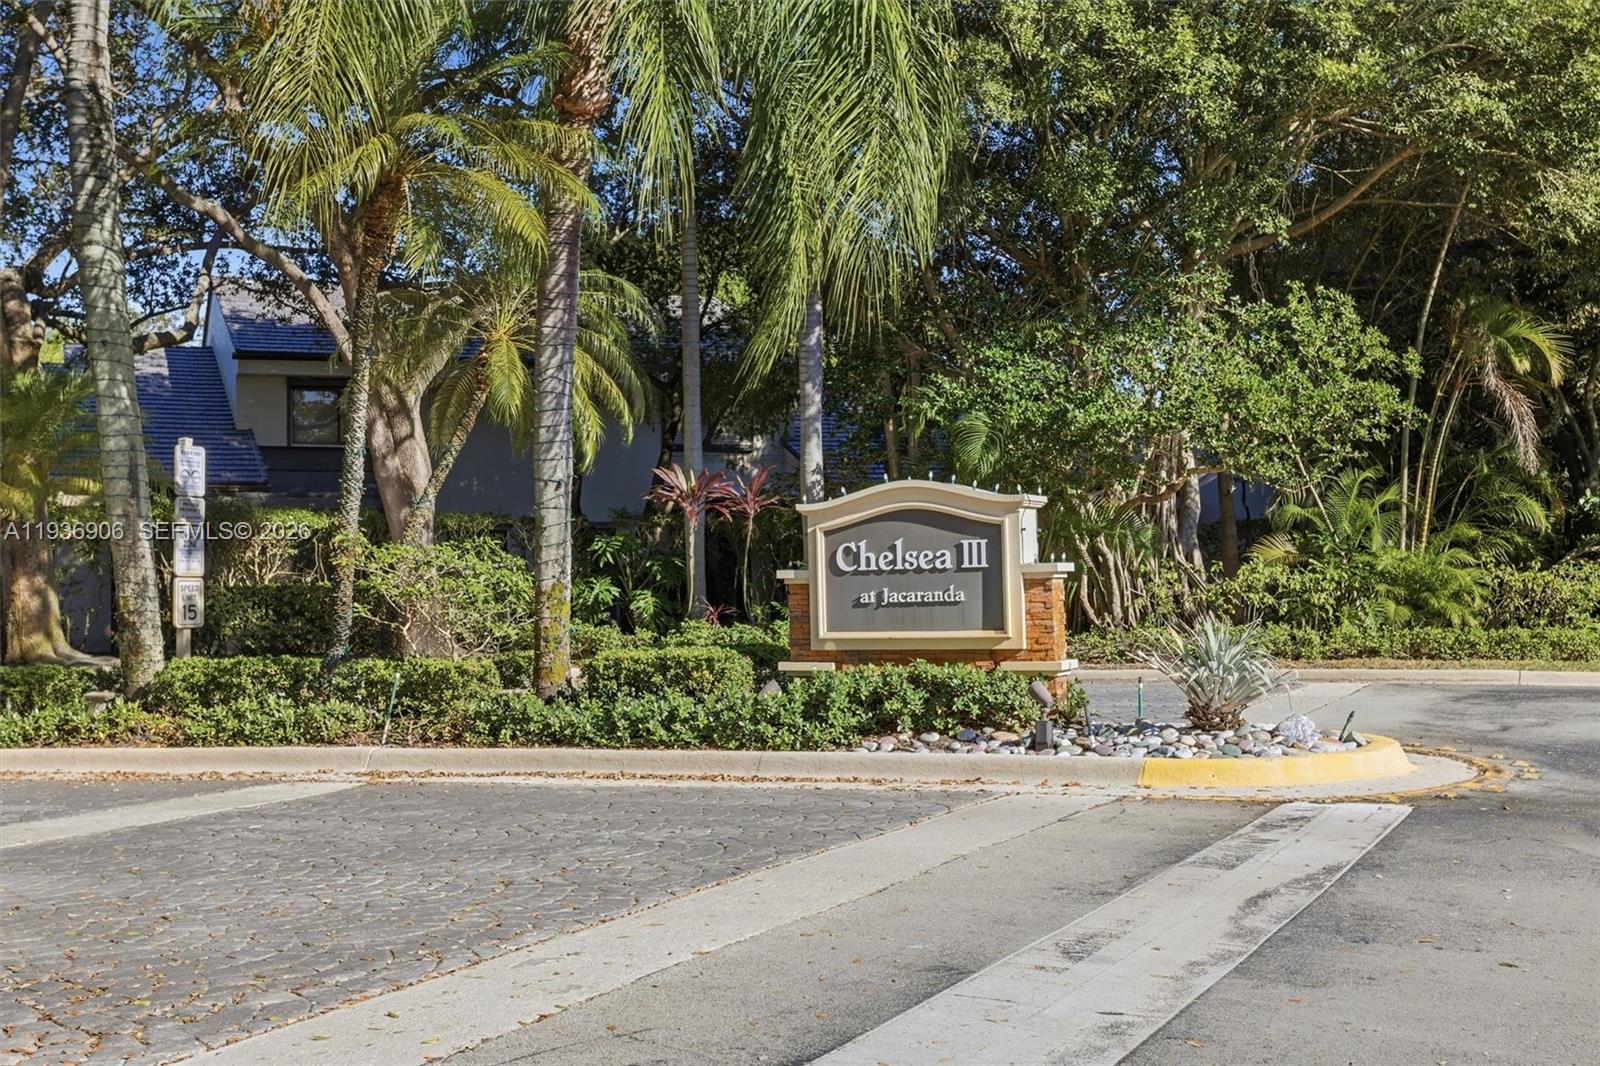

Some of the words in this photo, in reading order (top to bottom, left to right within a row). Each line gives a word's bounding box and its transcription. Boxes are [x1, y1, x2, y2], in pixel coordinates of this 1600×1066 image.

[835, 538, 953, 572] Chelsea
[960, 539, 989, 568] III
[860, 591, 876, 604] at
[881, 584, 965, 605] Jacaranda
[182, 604, 197, 620] 15
